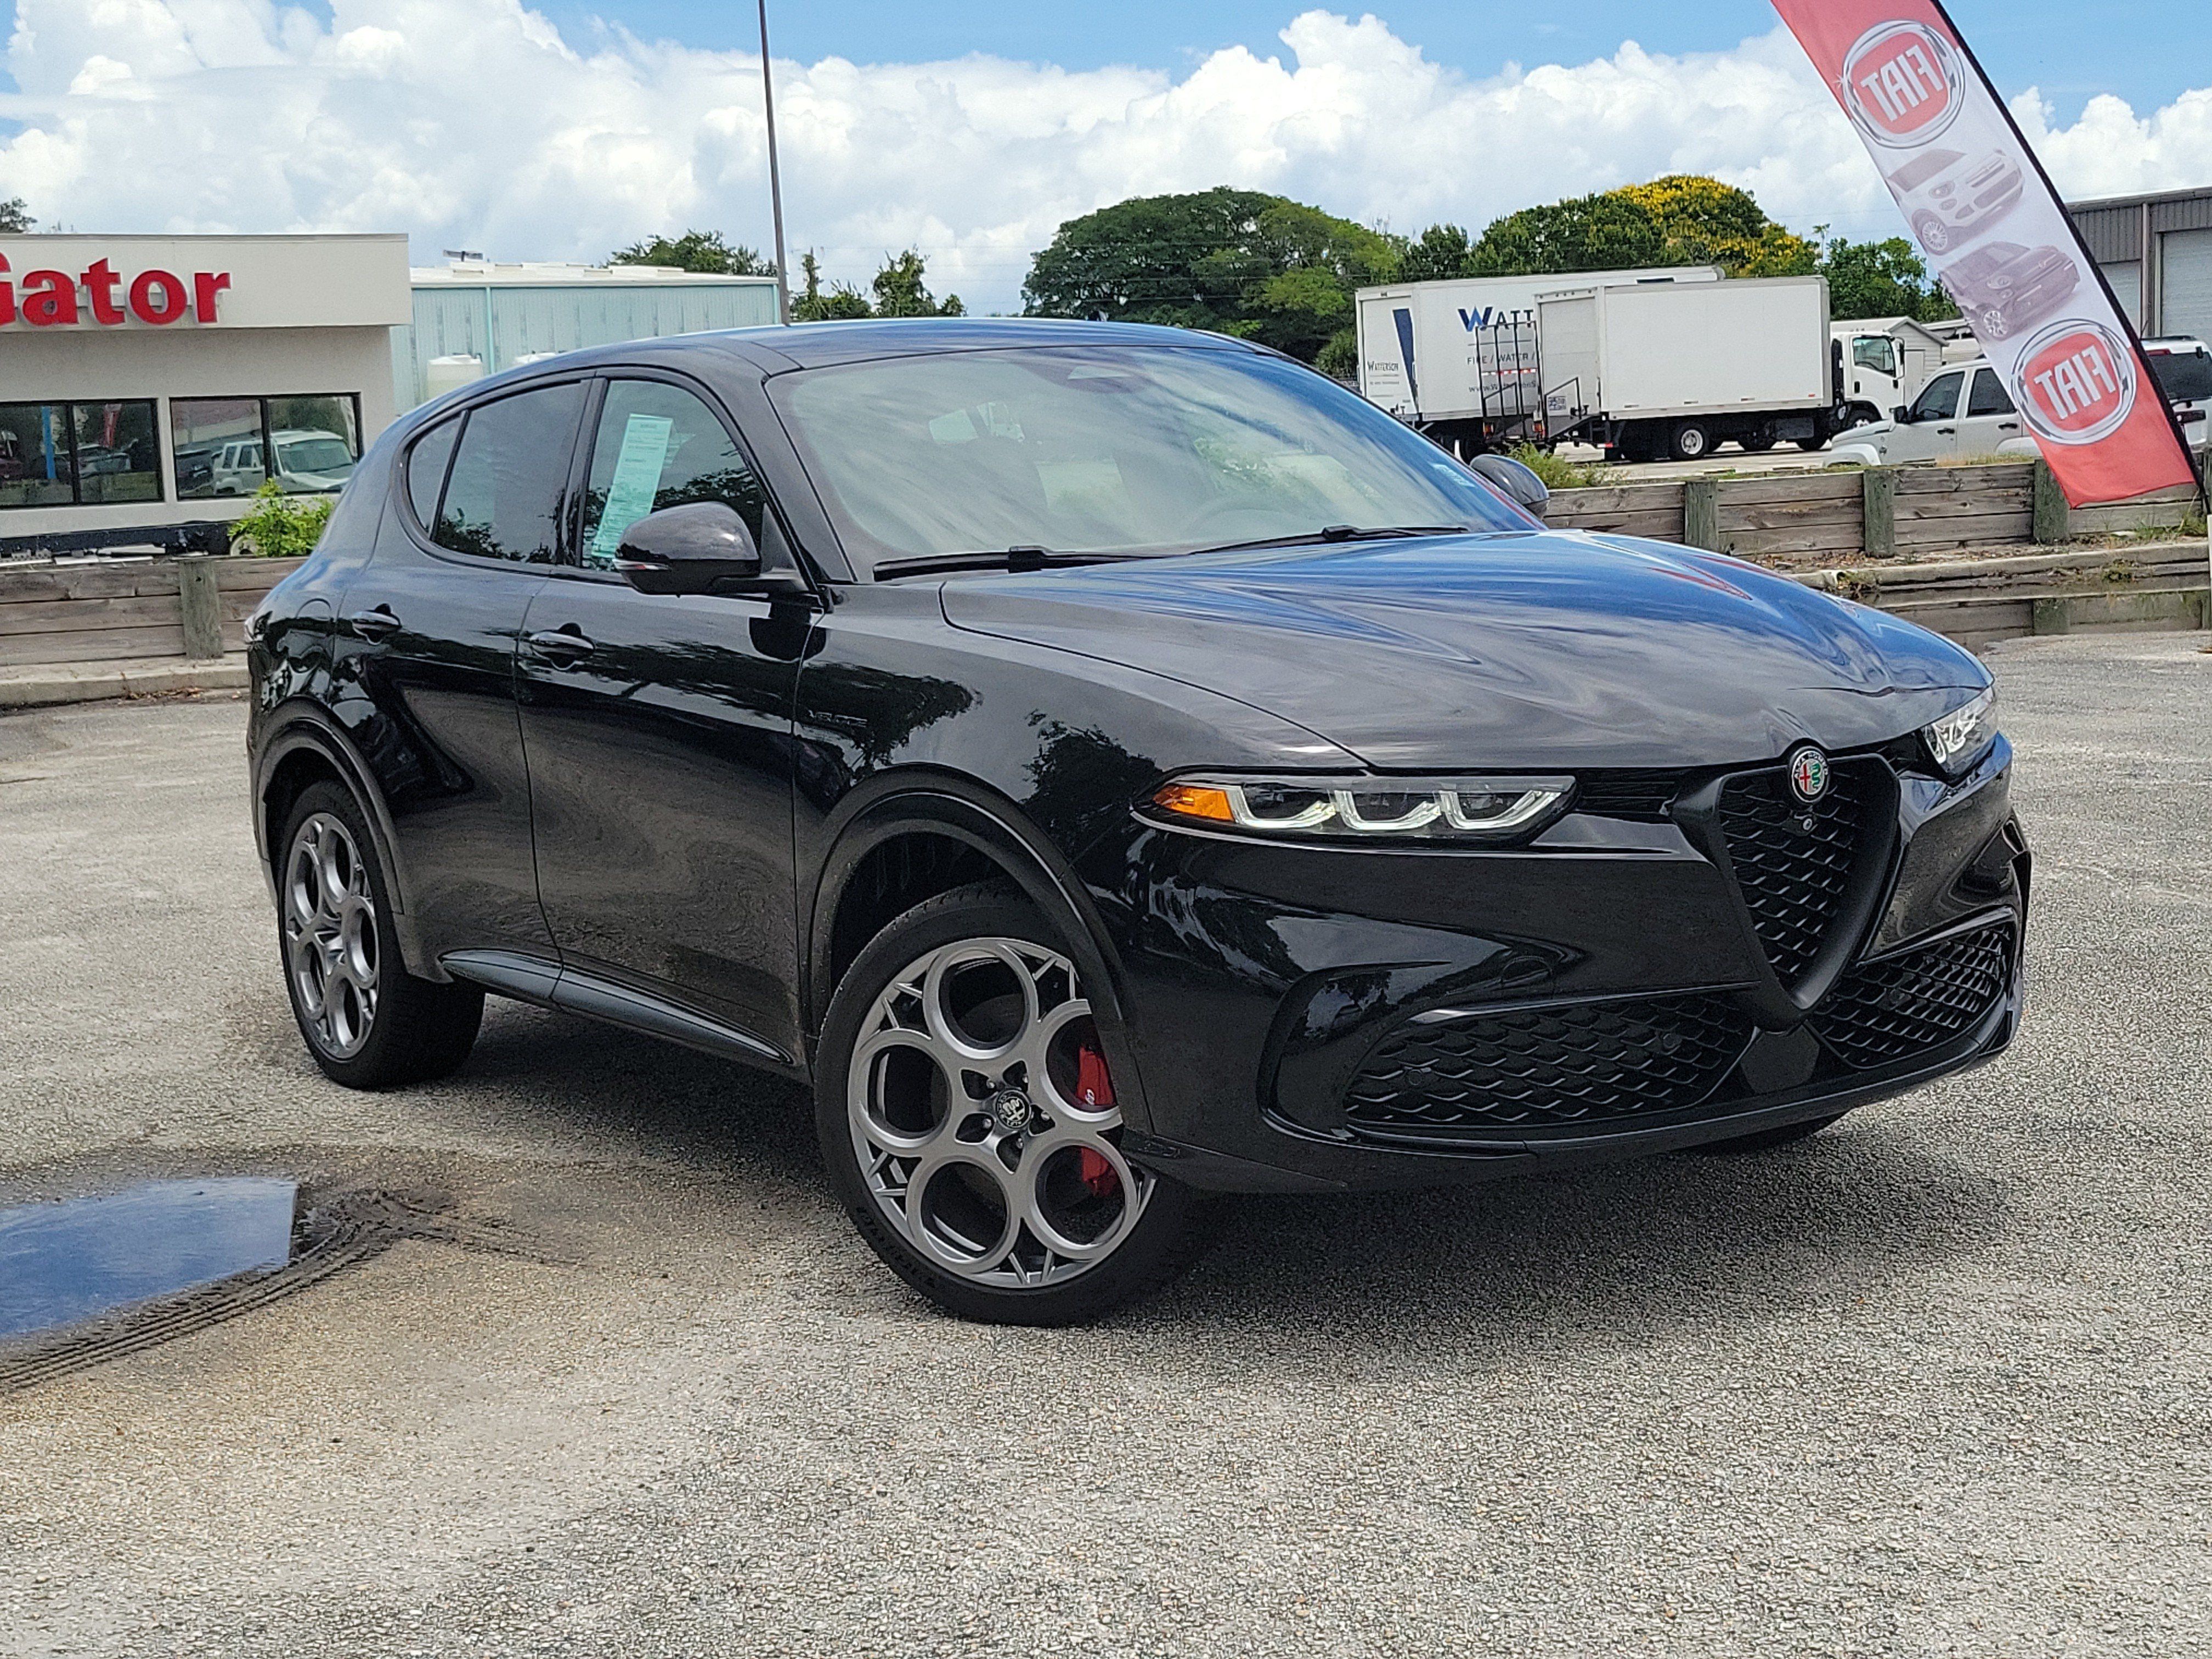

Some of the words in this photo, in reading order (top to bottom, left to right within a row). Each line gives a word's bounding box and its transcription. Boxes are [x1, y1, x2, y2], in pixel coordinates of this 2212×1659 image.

[0, 252, 231, 326] ator
[1467, 356, 1487, 365] FIE
[1499, 353, 1528, 362] WATR
